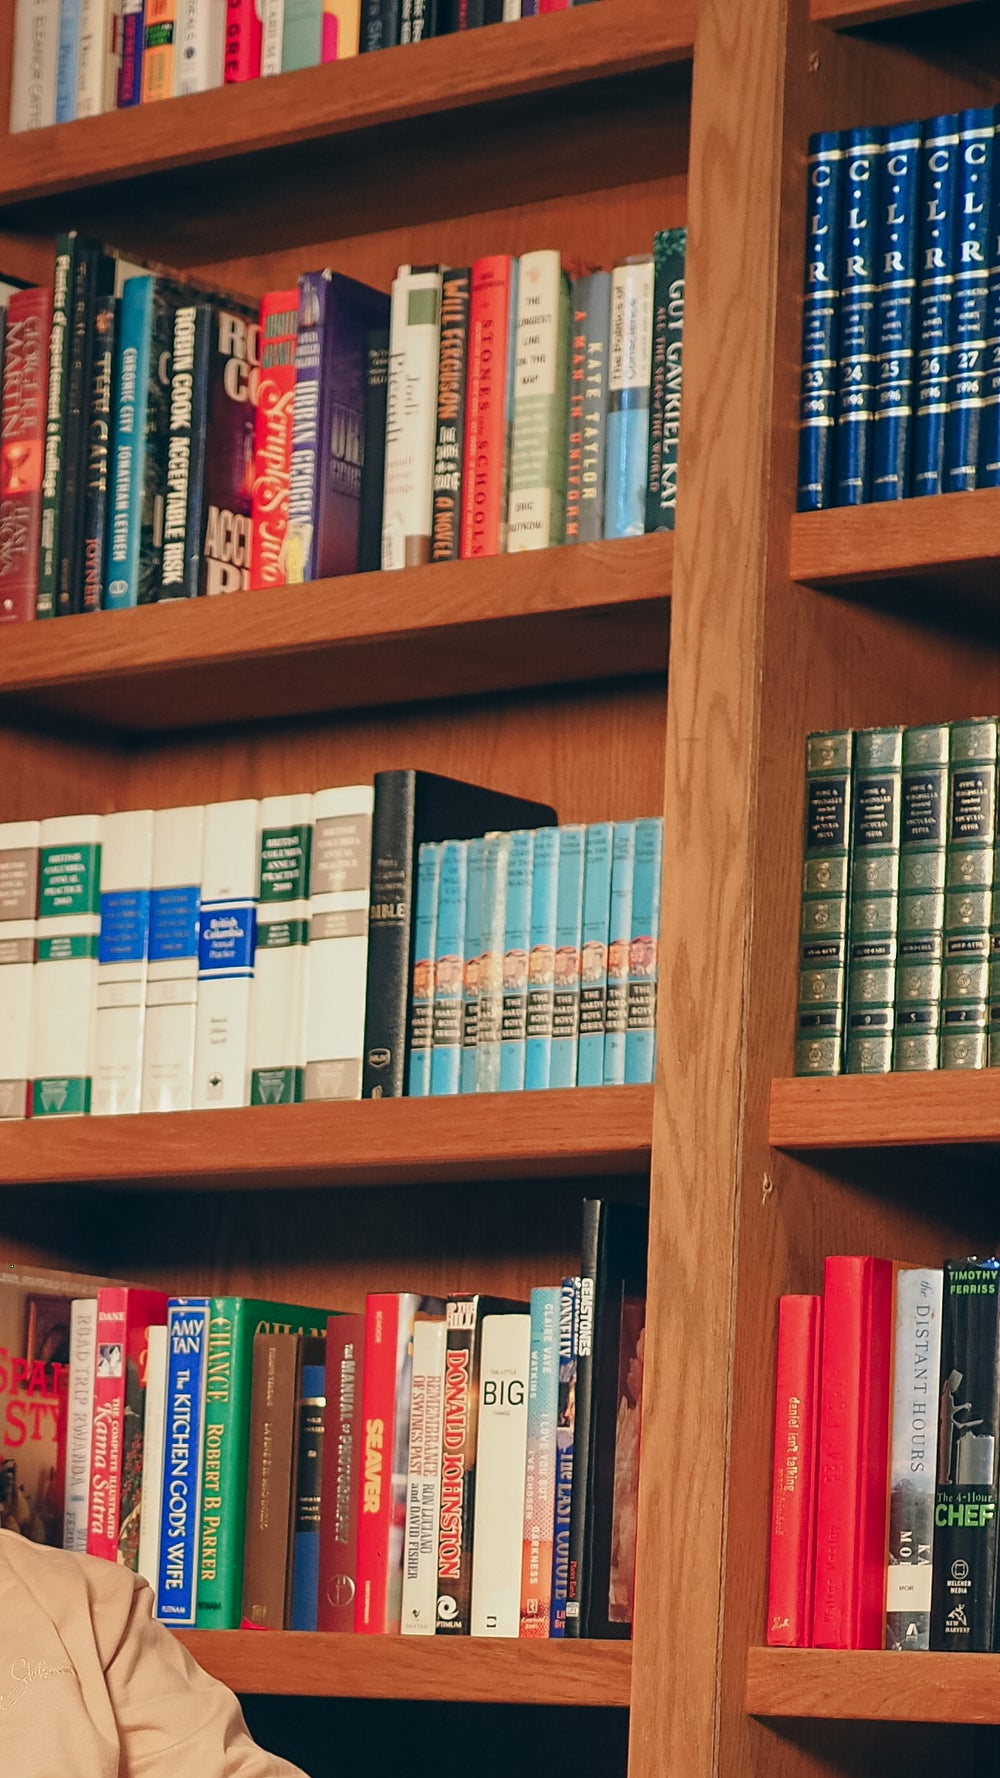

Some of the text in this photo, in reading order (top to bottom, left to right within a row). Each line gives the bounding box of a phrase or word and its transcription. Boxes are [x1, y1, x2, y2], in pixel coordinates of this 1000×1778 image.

[54, 256, 70, 307] Plantes
[22, 316, 41, 394] GEORGE
[438, 278, 469, 420] WILL FERGUSON
[479, 318, 493, 411] STONES
[611, 356, 623, 380] The
[627, 299, 638, 380] Conscience
[654, 336, 665, 364] THE
[844, 364, 862, 381] 24
[881, 360, 899, 378] 25
[922, 357, 940, 374] 26
[958, 350, 978, 368] 27
[1, 320, 23, 438] MARTIN
[92, 352, 111, 413] THE
[290, 380, 318, 443] URBAN
[405, 375, 420, 416] Jodi
[660, 279, 684, 509] GUY GAVRIEL KAY
[112, 348, 137, 561] CHRONIC CITY JONATHAN LETHEM
[161, 307, 197, 585] ROBIN COOK ACCEPTABLE RISK
[565, 311, 587, 536] A MAN IN UNIFORM
[582, 342, 604, 500] KATE TAYLOR
[652, 413, 662, 437] THE
[43, 436, 62, 497] feuillage
[473, 439, 489, 556] SCHOOLS
[650, 443, 661, 492] WORLD
[433, 511, 454, 558] NOVEL
[84, 538, 100, 606] JOYNER
[949, 1269, 998, 1282] TIMOTHY
[950, 1282, 995, 1295] FERRISS
[172, 1320, 204, 1336] AMY
[174, 1337, 199, 1353] TAN
[543, 1303, 554, 1373] CLAIRE VAYE
[579, 1278, 593, 1356] GEMSTONES
[72, 1315, 91, 1486] ROAD TRIP RWANDA
[484, 1380, 524, 1405] BIG
[529, 1351, 538, 1398] WATKINS
[910, 1281, 931, 1473] the DISTANT HOURS
[201, 1317, 232, 1580] CHANCE ROBERT B. PARKER
[335, 1360, 355, 1543] MANUAL PHOTOGRAPHY
[410, 1375, 426, 1475] OF SWINGS PAST
[423, 1376, 442, 1476] REMEMBRANCE
[539, 1421, 549, 1450] LOVE
[783, 1397, 800, 1492] daniel isn't talking
[91, 1402, 112, 1534] Kama Sutra
[107, 1399, 120, 1538] THE COMPLETE ILLUSTRATED
[165, 1370, 191, 1590] The KITCHEN GOD'S WIFE
[363, 1419, 385, 1513] SEAVER
[438, 1349, 469, 1578] DONALD JOHNSTON
[525, 1475, 534, 1519] CHOSEN
[539, 1454, 548, 1474] YOU
[937, 1492, 993, 1503] The 4-Hour
[407, 1483, 421, 1579] and DAVID FISHER
[420, 1483, 435, 1554] RON LUCIANO
[935, 1504, 995, 1527] CHEF
[530, 1527, 540, 1584] DARKNESS
